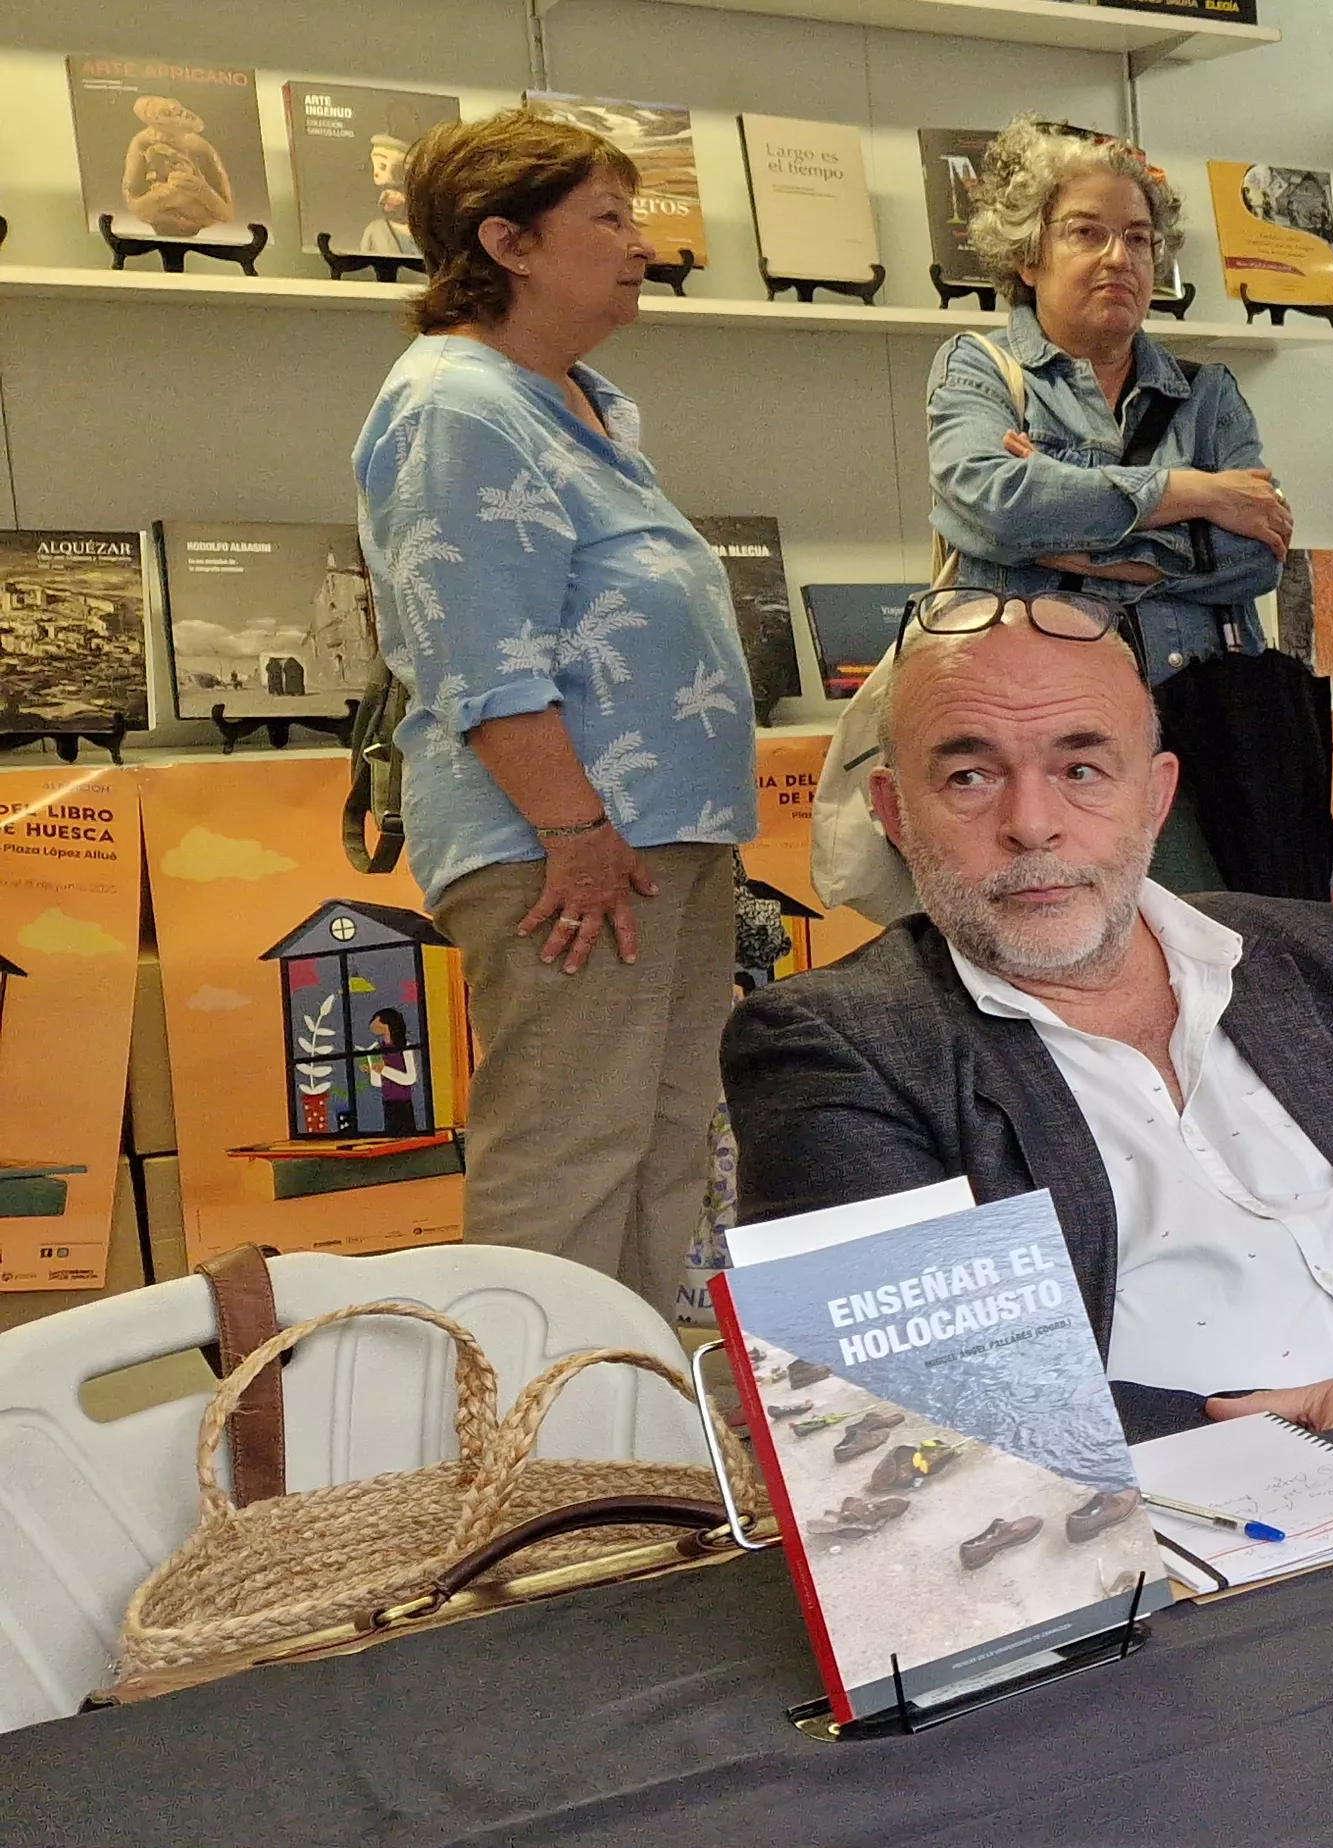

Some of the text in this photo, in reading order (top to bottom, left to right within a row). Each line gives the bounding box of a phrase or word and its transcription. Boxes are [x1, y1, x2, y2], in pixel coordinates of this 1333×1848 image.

[82, 59, 136, 76] ARTE
[144, 63, 248, 87] AFRICANO
[305, 94, 332, 106] ARTE
[306, 105, 353, 118] INGENUO
[765, 142, 839, 163] Largo es
[768, 160, 845, 182] el tiempo
[37, 539, 132, 556] ALQUÉZAR
[187, 541, 229, 552] RODOLFO
[728, 545, 771, 557] BLECUA
[779, 792, 800, 805] DE
[48, 805, 114, 822] LIBRO
[26, 822, 115, 843] HUESCA
[3, 843, 40, 855] Plaza
[43, 847, 81, 859] López
[827, 1244, 1055, 1328] ENSEÑAR EL
[838, 1279, 1063, 1366] HOLOCAUSTO
